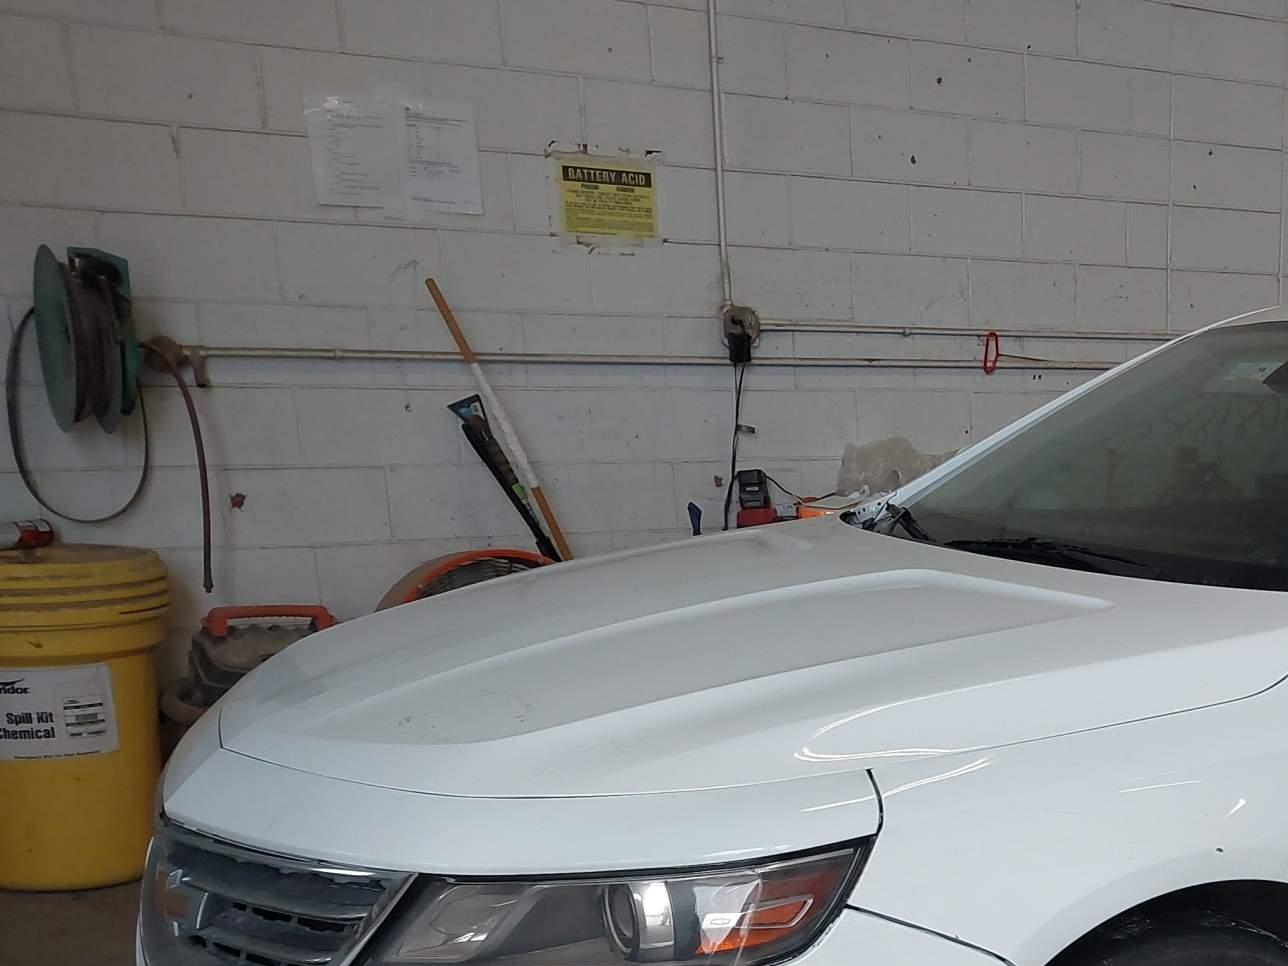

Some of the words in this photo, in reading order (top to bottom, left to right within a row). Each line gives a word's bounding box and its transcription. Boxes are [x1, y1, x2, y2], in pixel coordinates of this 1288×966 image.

[568, 168, 616, 183] BATTERY
[621, 172, 646, 186] ACID
[6, 712, 33, 727] Spill
[36, 711, 55, 724] Kit
